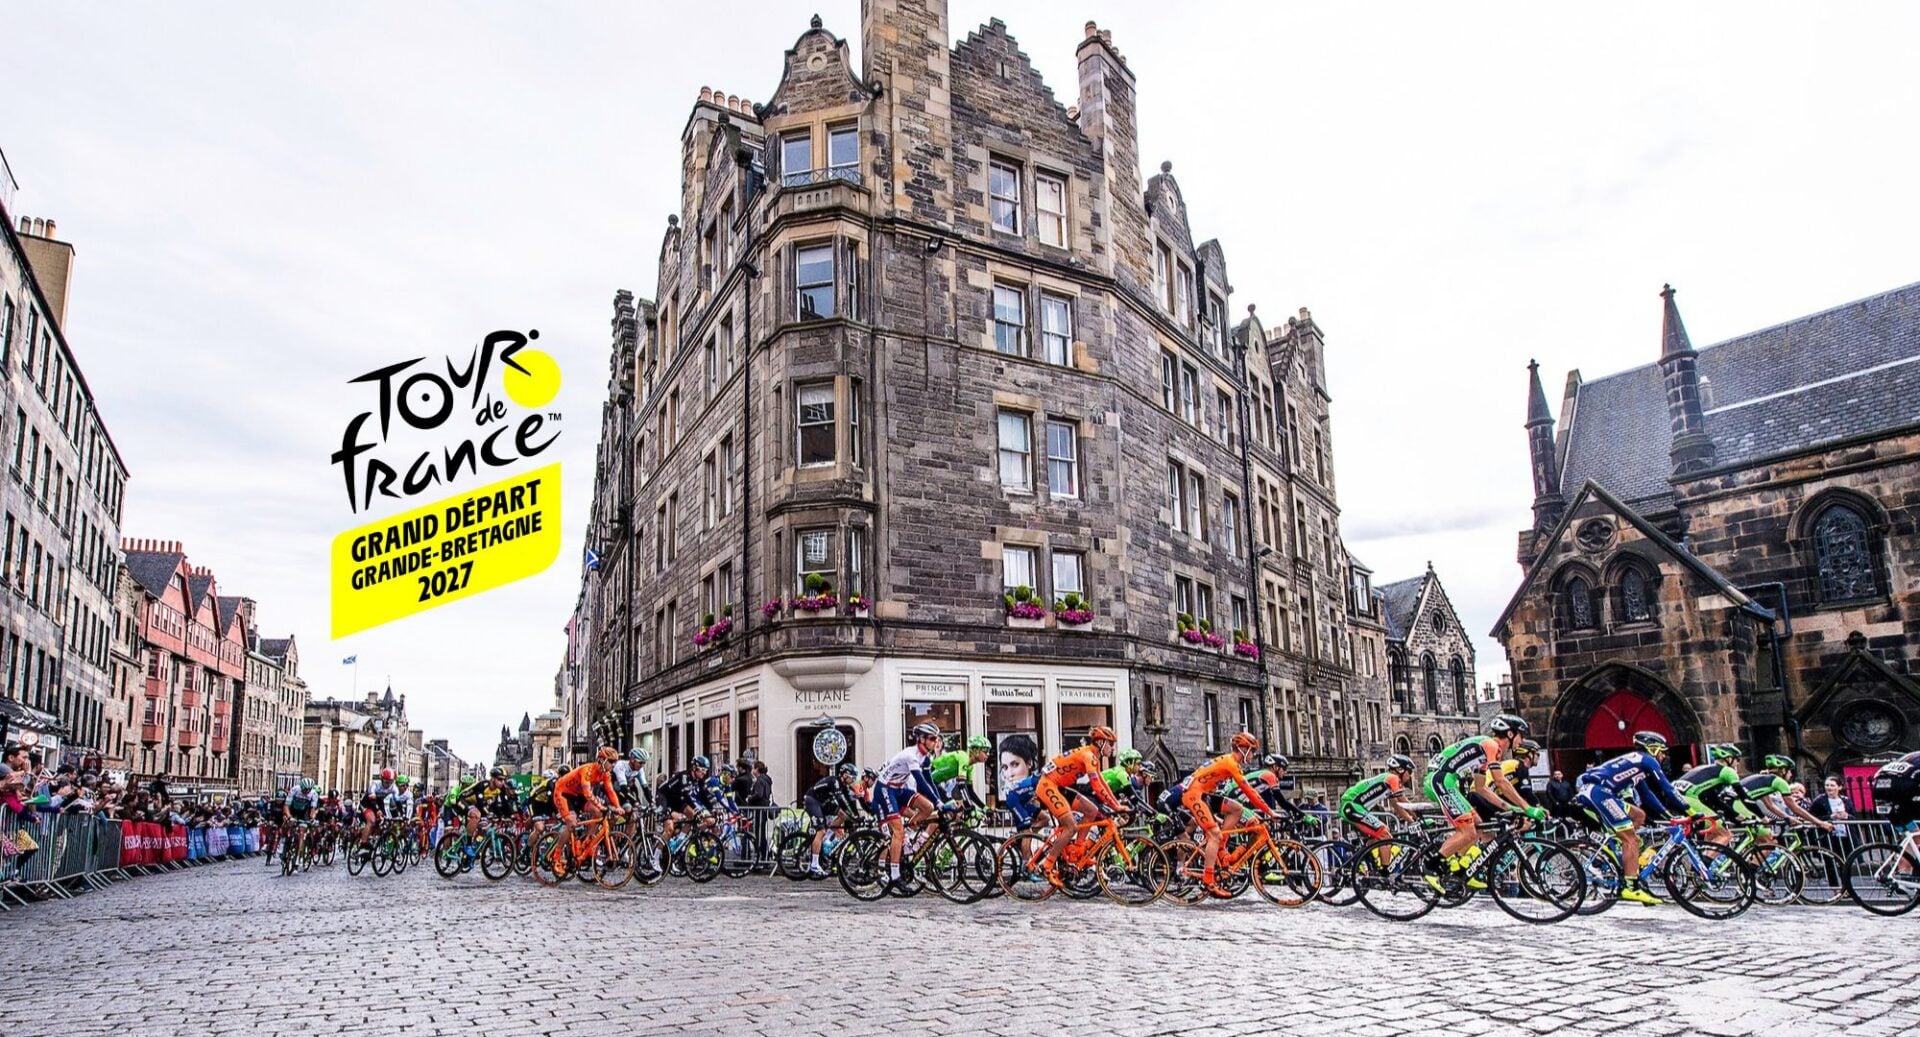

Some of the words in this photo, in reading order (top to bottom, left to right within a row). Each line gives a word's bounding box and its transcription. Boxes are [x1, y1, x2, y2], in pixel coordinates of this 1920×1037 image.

[915, 684, 953, 692] PRINGLE
[990, 687, 1014, 698] Harris
[1014, 689, 1034, 698] Tweed
[1060, 690, 1112, 699] STRATHBERRY
[795, 689, 851, 703] KILTANE
[1056, 763, 1078, 775] CCC
[1045, 788, 1064, 809] CCC
[1192, 802, 1209, 823] CCC
[1466, 839, 1499, 877] CIPOLLINI
